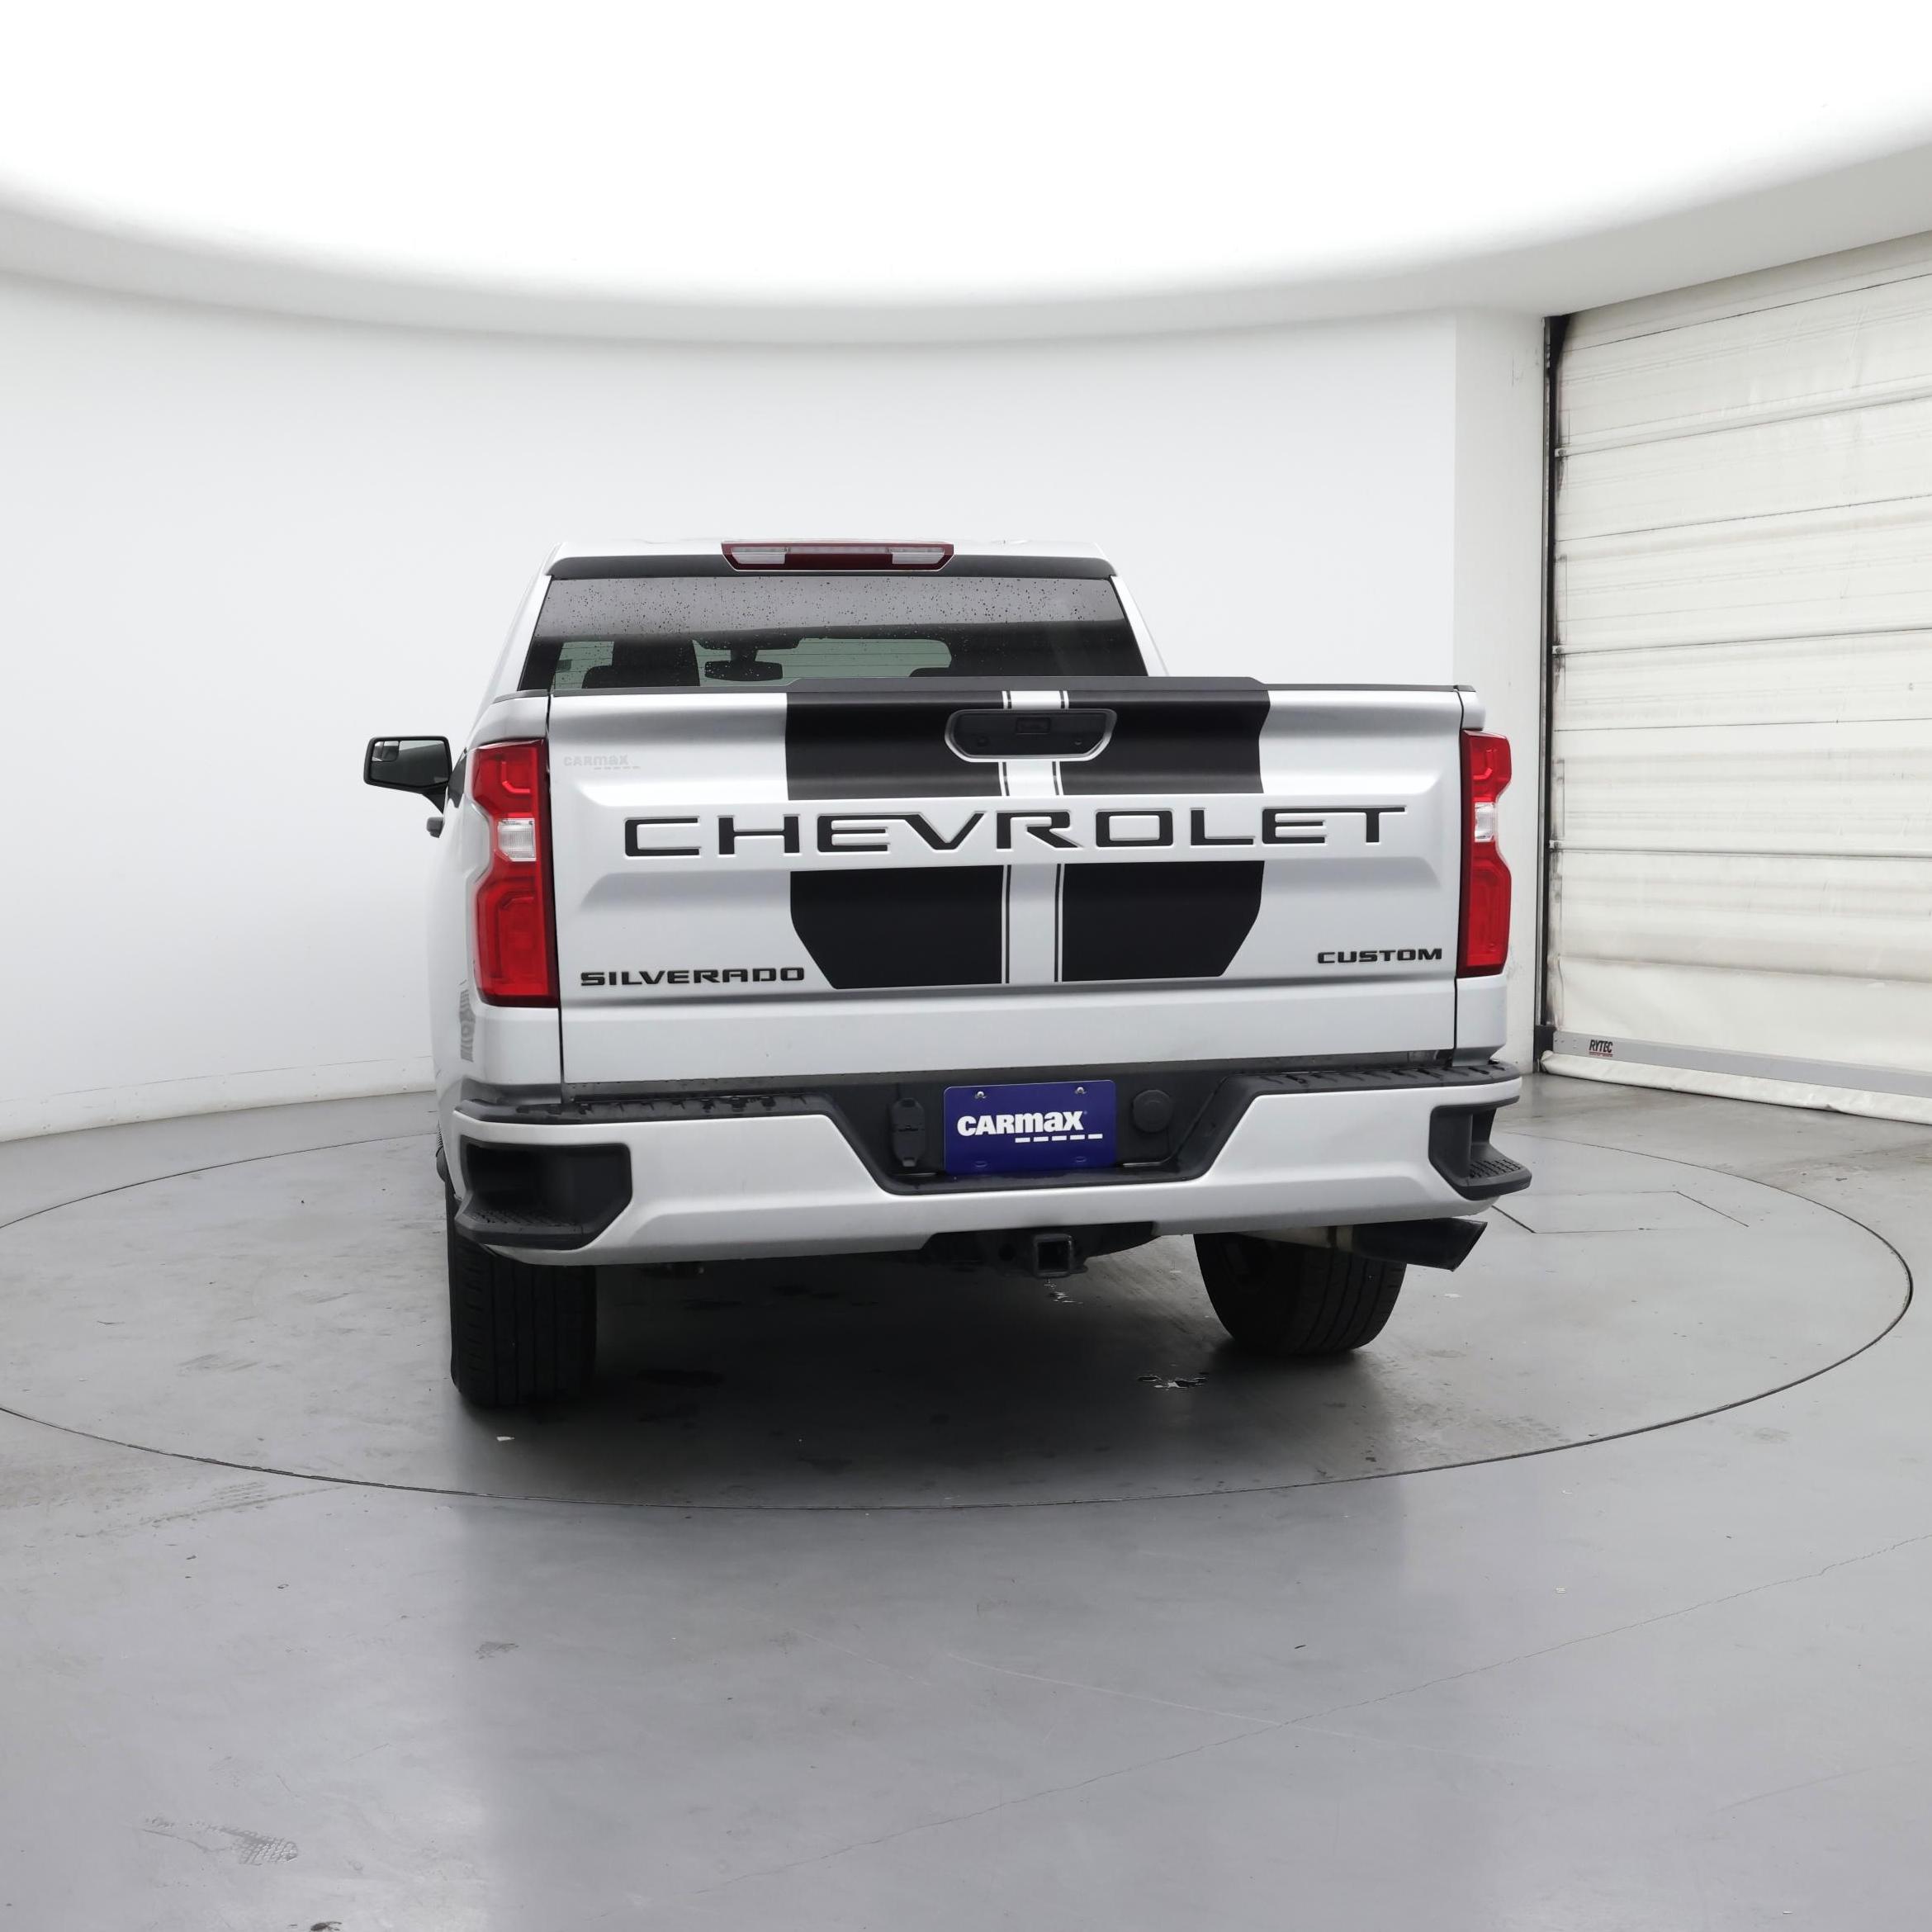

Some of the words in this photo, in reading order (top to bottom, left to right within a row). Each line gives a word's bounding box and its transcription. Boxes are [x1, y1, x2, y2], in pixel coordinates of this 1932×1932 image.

[625, 807, 1406, 856] CHEVROLET
[1317, 948, 1442, 964] CUSTOM
[580, 967, 805, 986] SILVERADO
[1589, 1039, 1613, 1054] RYTEC
[957, 1110, 1084, 1136] CARmax
